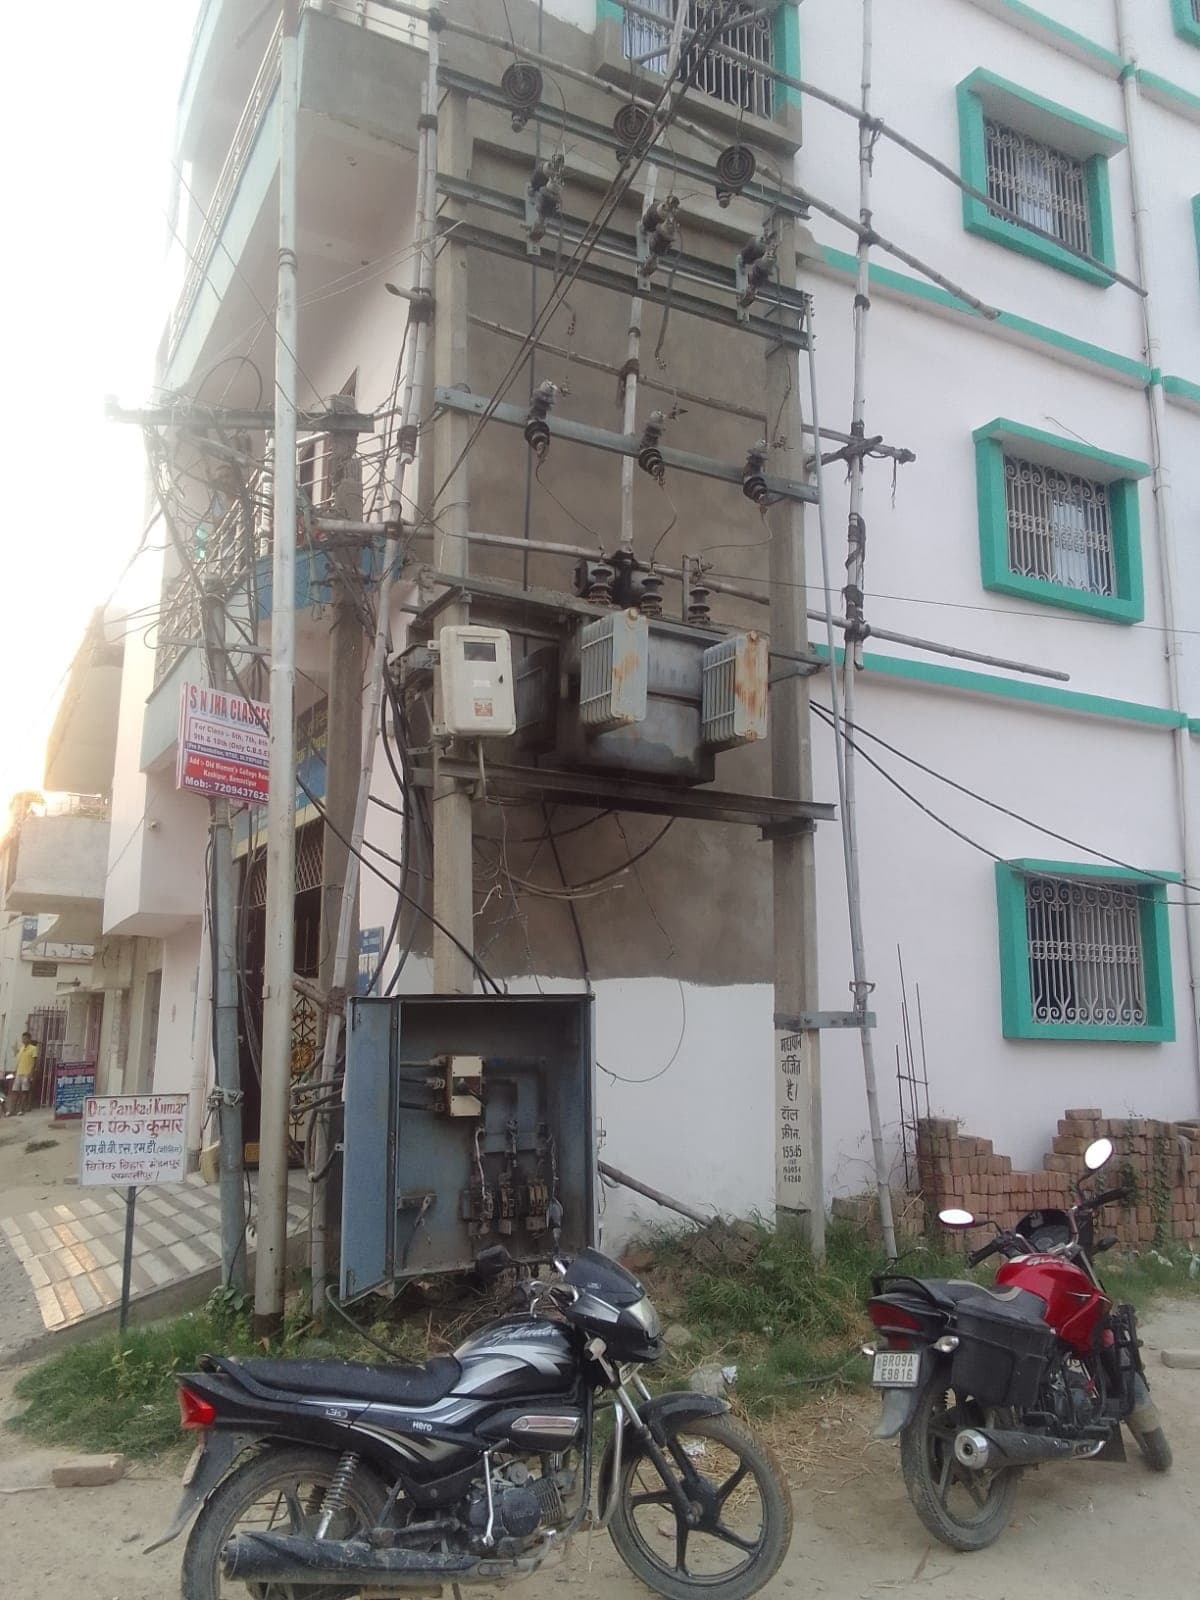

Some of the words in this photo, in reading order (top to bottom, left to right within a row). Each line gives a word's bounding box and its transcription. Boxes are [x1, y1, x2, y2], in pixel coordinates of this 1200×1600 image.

[190, 685, 197, 710] S
[200, 690, 207, 713] N
[209, 693, 228, 719] JHA
[194, 722, 206, 733] For
[110, 1098, 153, 1116] Pankaj
[154, 1098, 186, 1114] Kumar
[146, 1118, 184, 1138] कुमार
[882, 1354, 913, 1367] BR09A
[881, 1368, 913, 1381] E9816
[412, 1420, 433, 1432] Hero
